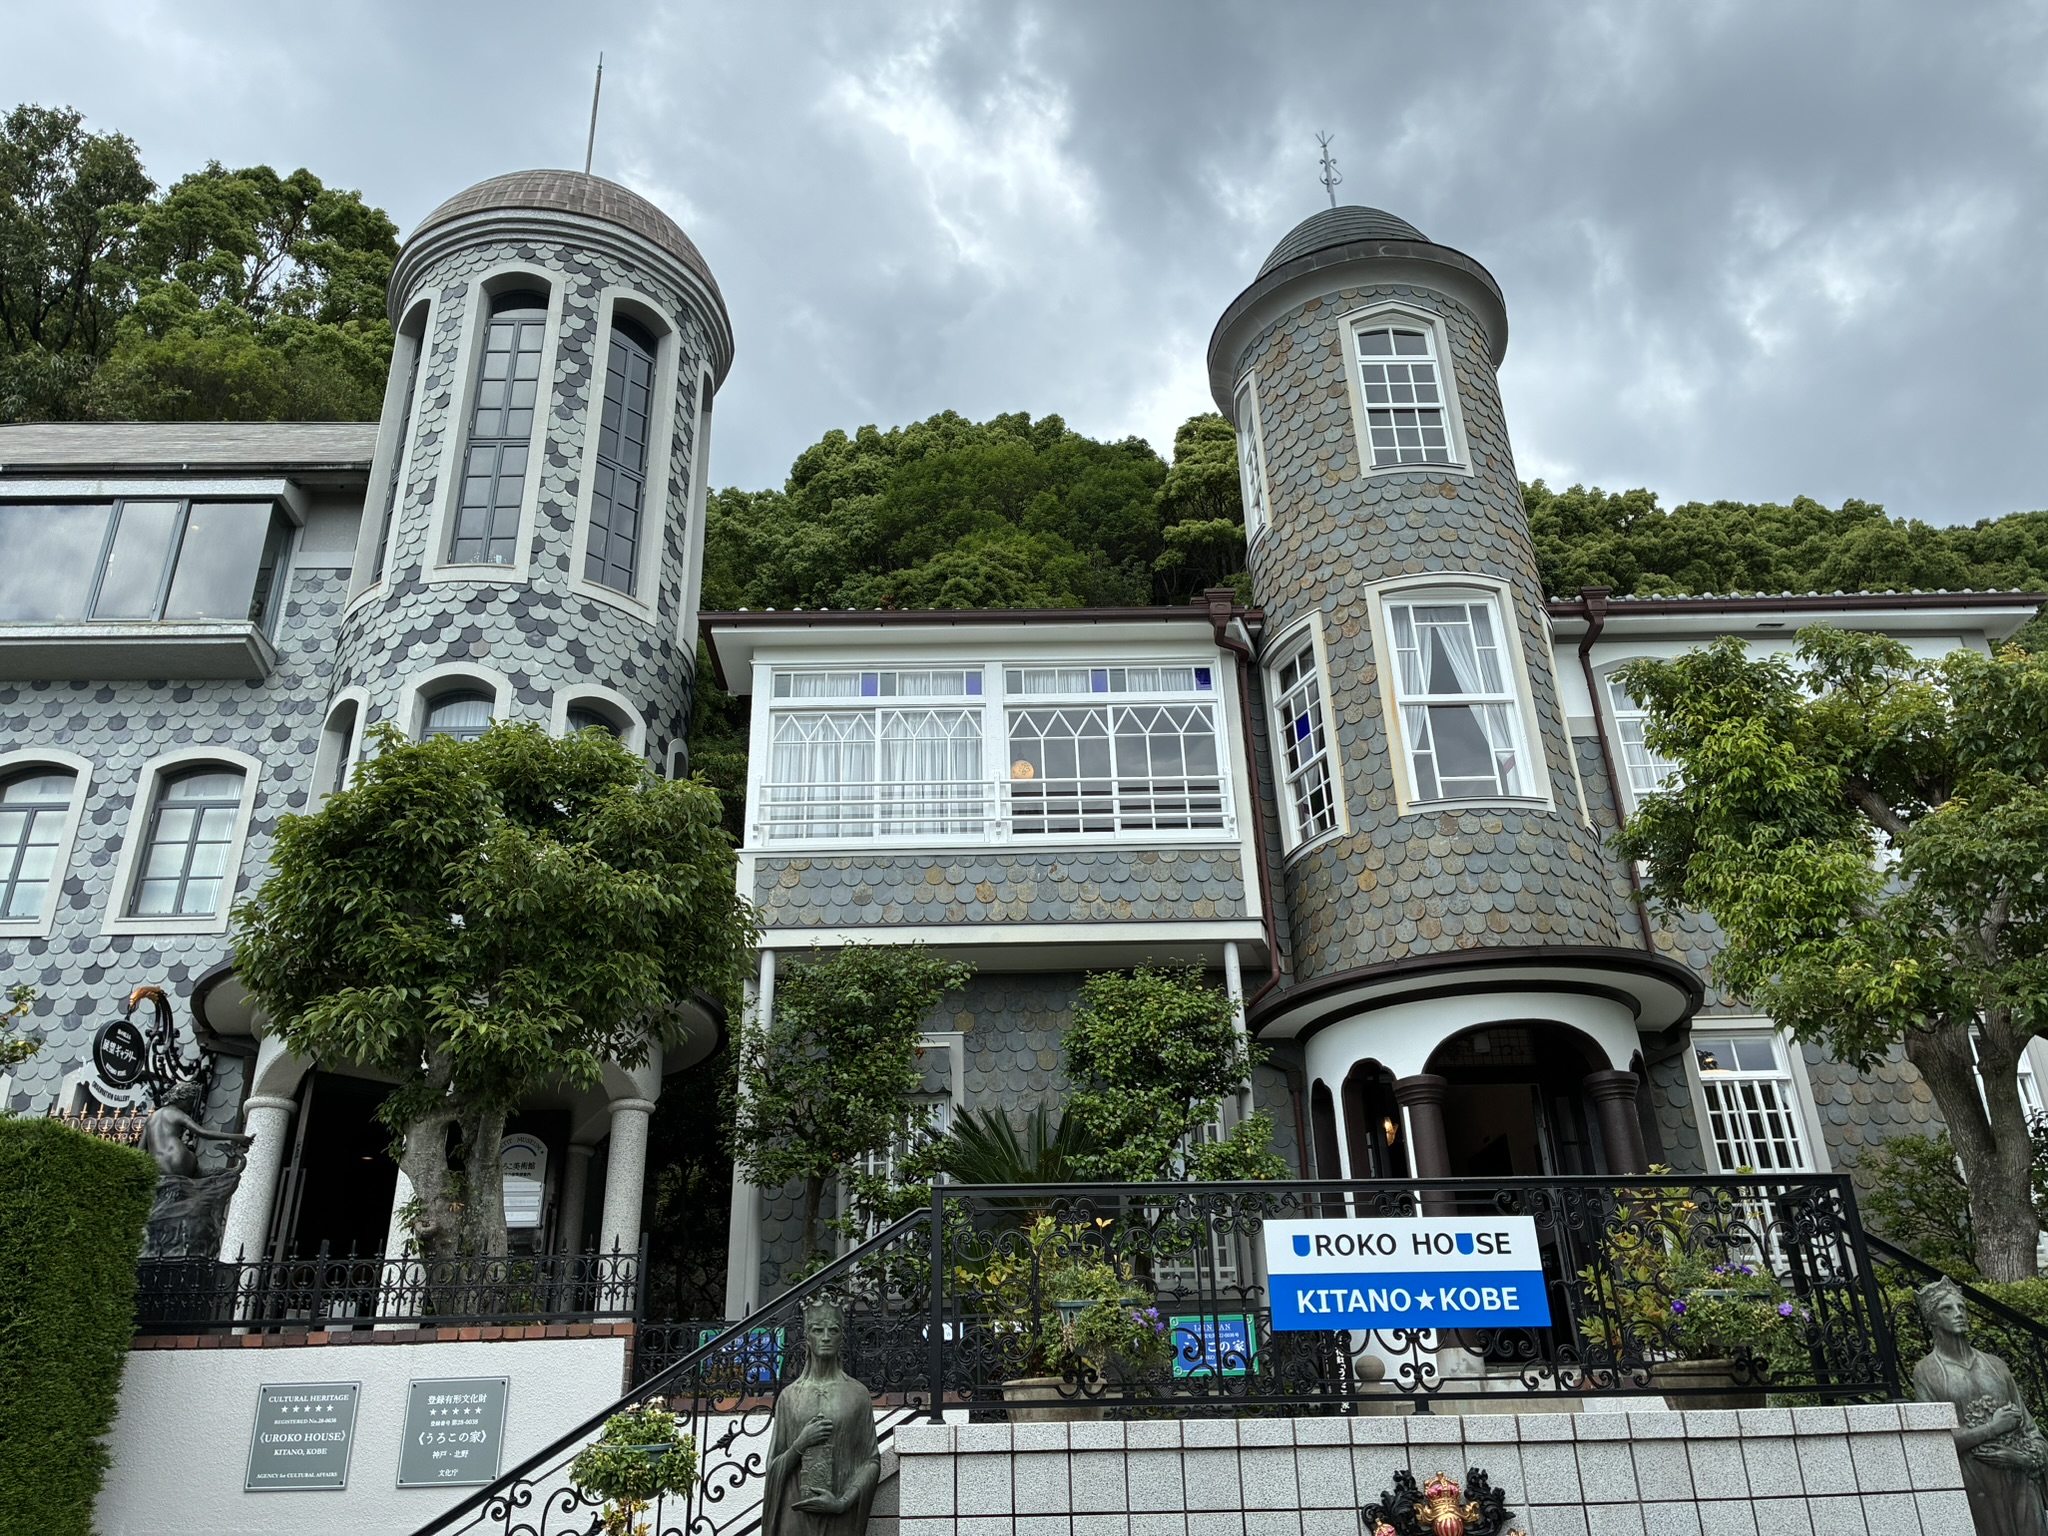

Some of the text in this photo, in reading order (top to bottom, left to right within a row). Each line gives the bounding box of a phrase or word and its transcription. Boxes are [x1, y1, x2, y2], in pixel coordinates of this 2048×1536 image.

[102, 1038, 137, 1063] 展望ギャラリー
[114, 1094, 130, 1102] GALLERY
[516, 1136, 542, 1152] MUSEUM
[502, 1161, 536, 1171] ろこ美術館
[1292, 1232, 1512, 1257] UROKO HOUSE
[268, 1394, 350, 1403] CULTURAL HERITAGE
[427, 1393, 488, 1406] 登録有形文化財
[273, 1447, 328, 1456] KITANO, KOBE
[432, 1449, 469, 1460] 神戸・北野
[437, 1468, 459, 1477] 文化庁
